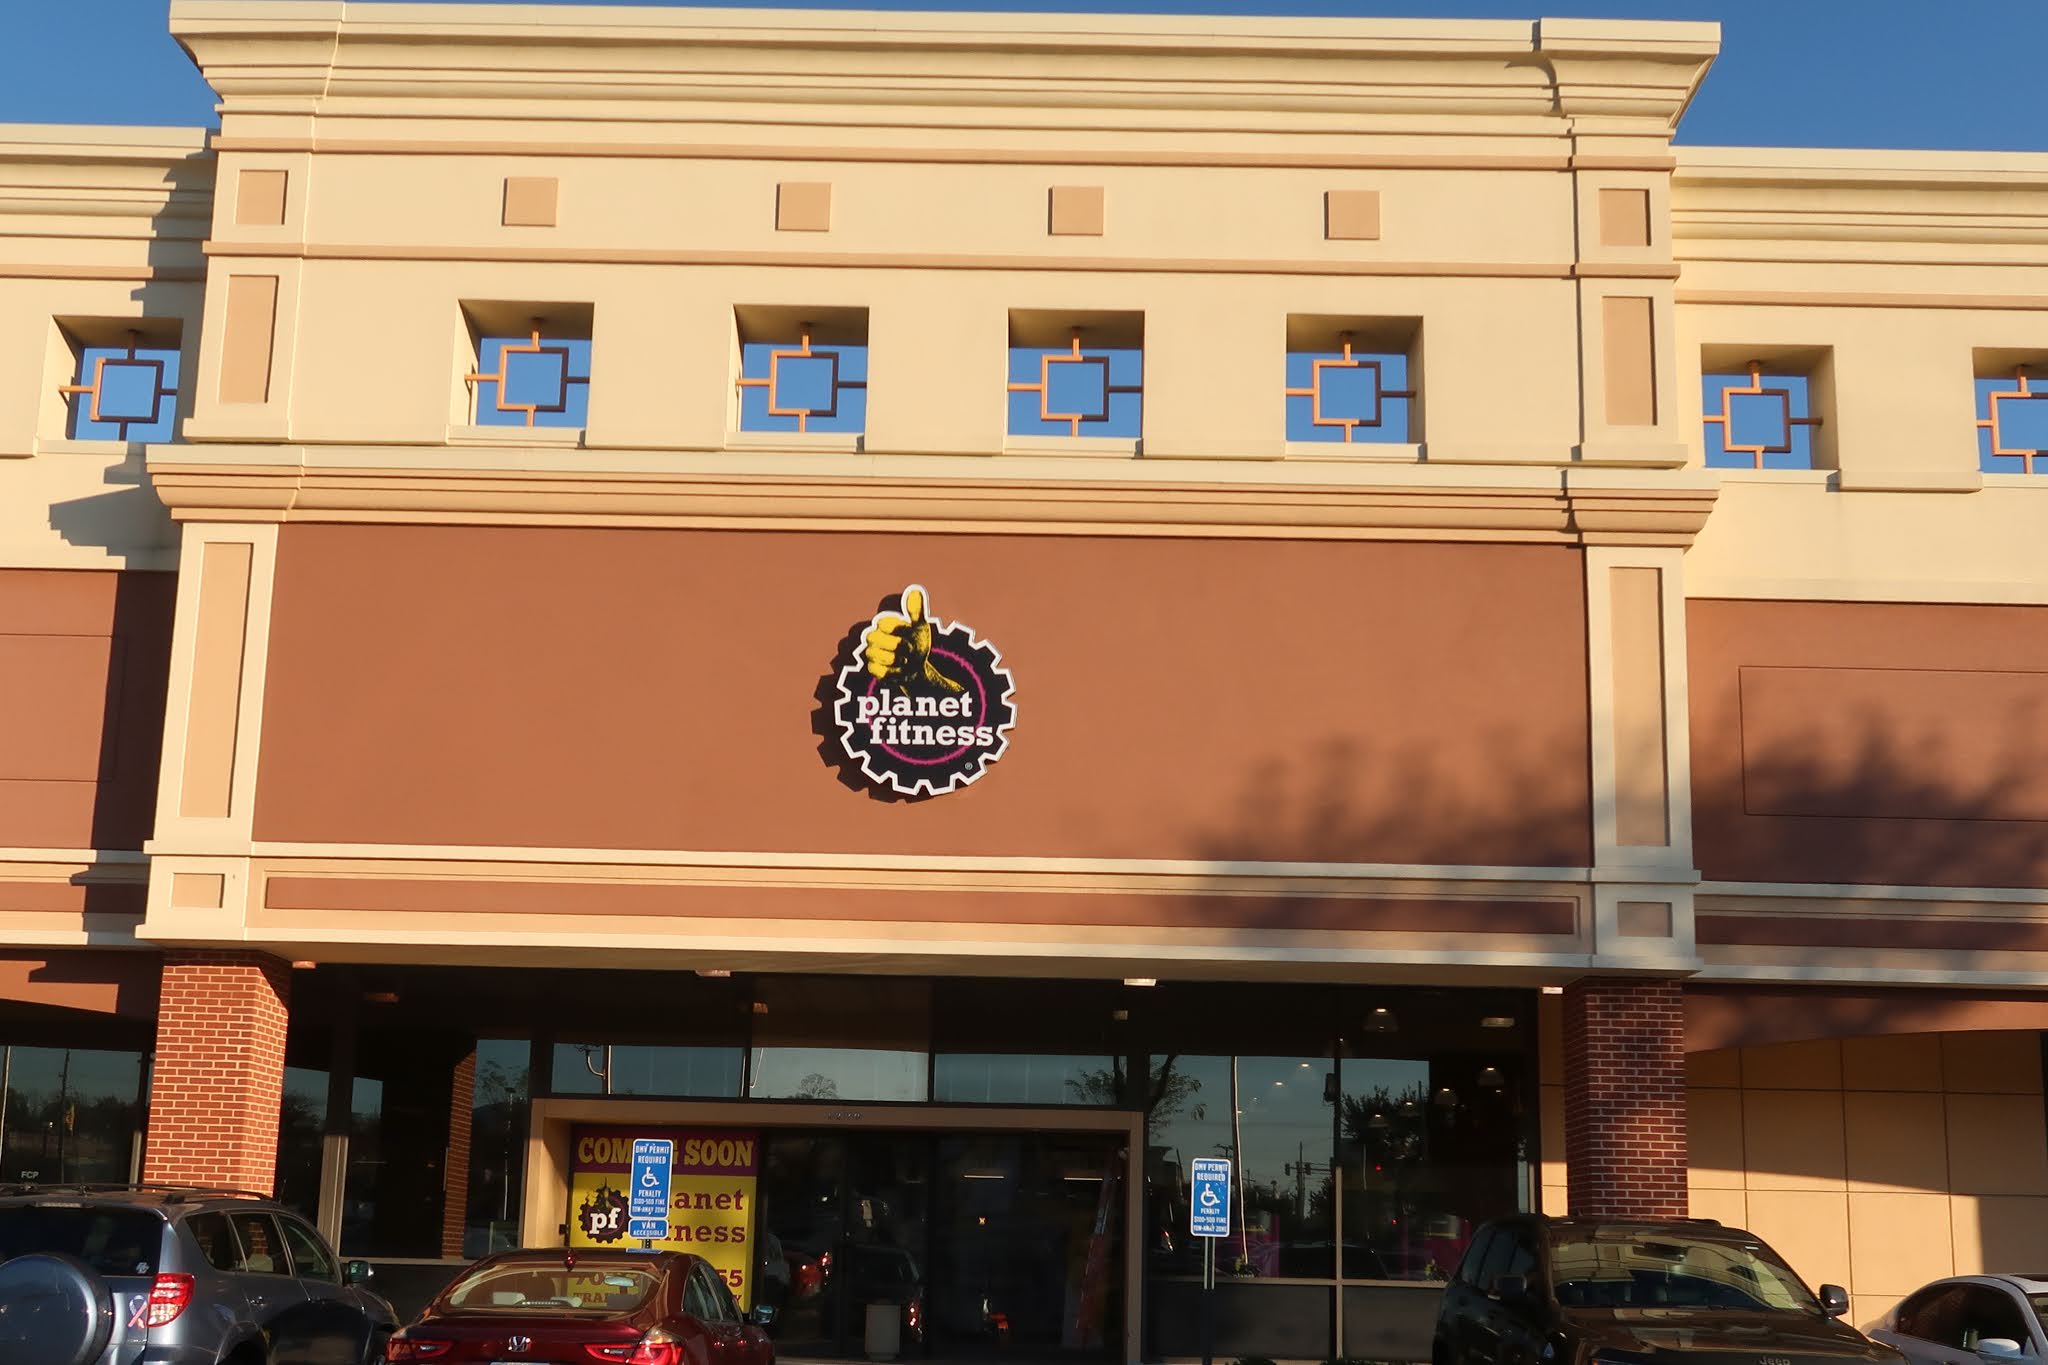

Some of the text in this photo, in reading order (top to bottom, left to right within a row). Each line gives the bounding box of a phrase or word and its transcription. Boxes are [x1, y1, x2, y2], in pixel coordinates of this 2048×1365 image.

[856, 689, 973, 723] planet
[870, 717, 994, 746] fitness
[578, 1137, 754, 1166] COM SOON
[636, 1145, 670, 1154] DMV PERMIT
[638, 1156, 666, 1164] REQUIRED
[1195, 1163, 1228, 1172] DMV PERMIT
[1197, 1173, 1225, 1181] REQUIRED
[670, 1188, 743, 1210] anet
[589, 1207, 621, 1234] pf
[641, 1221, 656, 1229] VAN
[664, 1220, 746, 1243] ness
